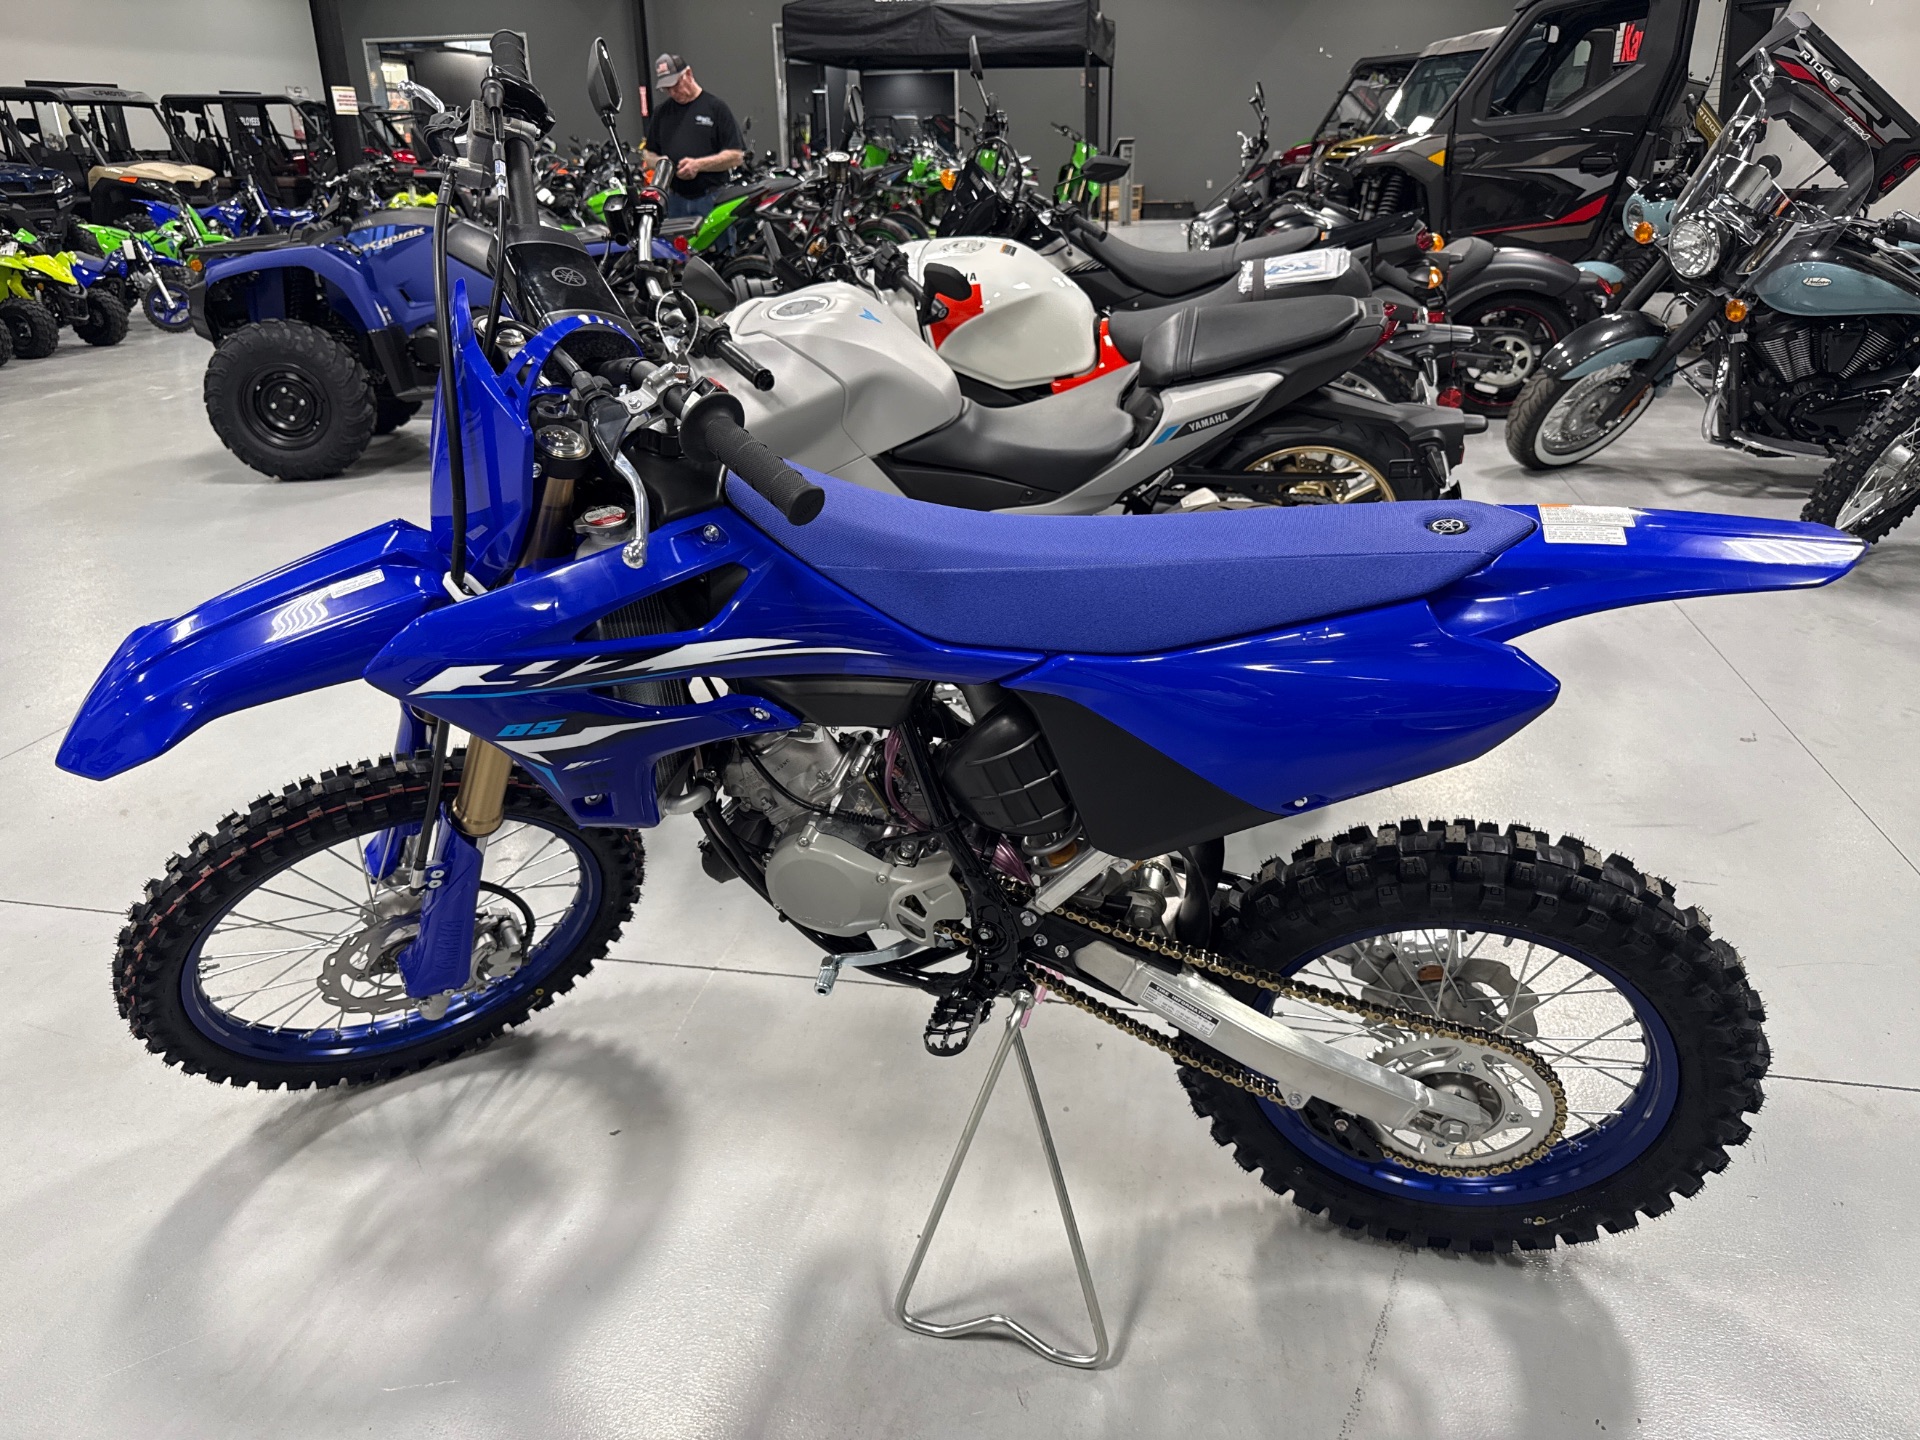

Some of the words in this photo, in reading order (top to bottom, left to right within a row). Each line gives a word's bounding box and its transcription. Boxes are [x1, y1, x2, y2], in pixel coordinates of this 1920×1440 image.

[1800, 49, 1840, 88] RIDGE
[1188, 412, 1229, 432] YAMAHA
[496, 719, 567, 737] 85
[1156, 985, 1170, 997] TIRE
[1171, 995, 1213, 1021] INFORMATION
